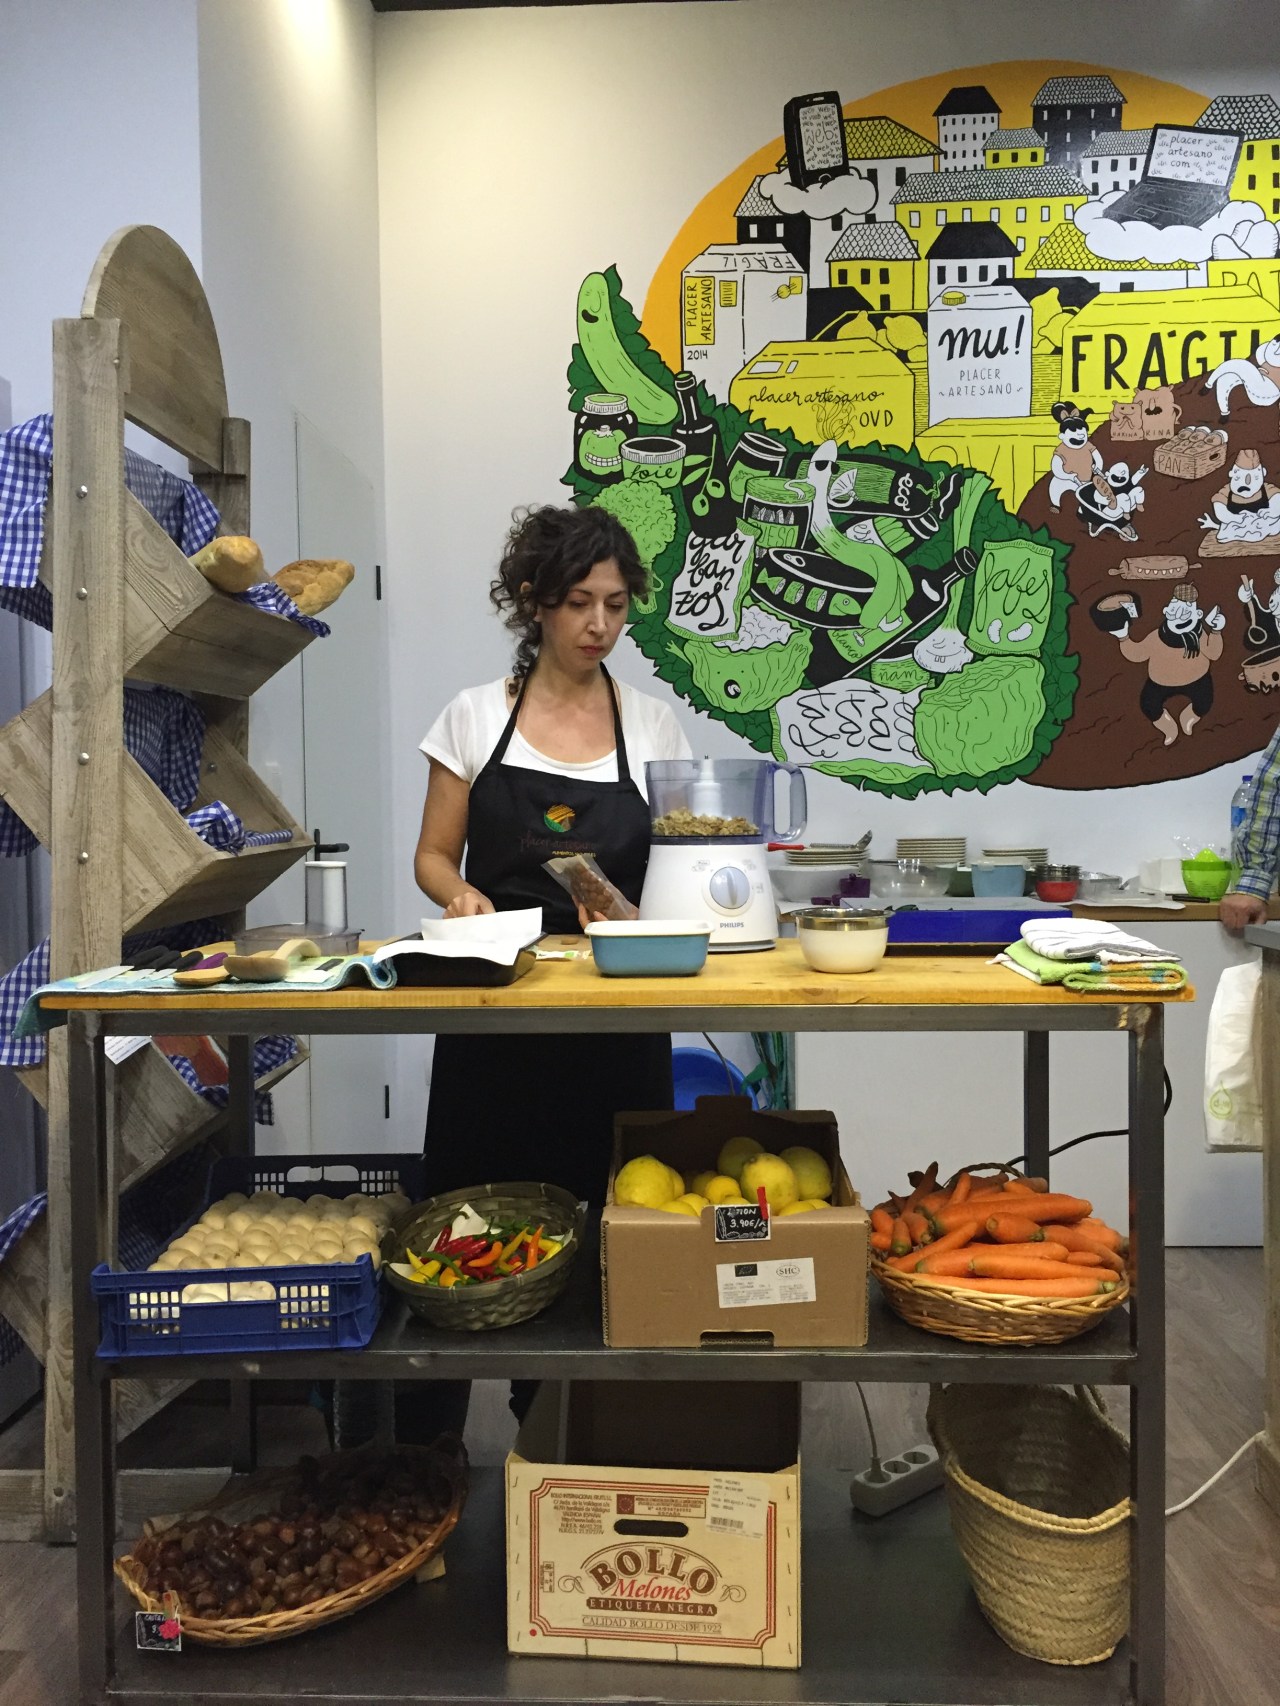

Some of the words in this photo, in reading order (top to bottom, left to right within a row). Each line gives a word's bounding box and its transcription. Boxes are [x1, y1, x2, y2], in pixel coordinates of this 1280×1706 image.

[1170, 132, 1204, 148] placer
[1168, 147, 1213, 158] artesano
[1170, 159, 1191, 168] com
[723, 255, 797, 270] FRAGIL
[686, 282, 698, 327] PLACER
[700, 278, 713, 341] ARTESANO
[937, 314, 1026, 361] mu!
[687, 349, 709, 361] 2014
[960, 368, 1001, 381] PLACER
[948, 383, 1012, 397] ARTESANO
[859, 409, 894, 427] OVD
[630, 464, 678, 481] foie
[1157, 454, 1182, 474] PAN
[893, 473, 914, 512] eco
[687, 553, 736, 591] ban
[675, 581, 730, 632] zos
[878, 668, 924, 682] ñam
[588, 1547, 716, 1594] BOLLO
[611, 1577, 693, 1601] Melones
[589, 1599, 662, 1612] ETIQUETA
[667, 1604, 714, 1615] NEGRA
[582, 1616, 627, 1627] CALIDAD
[629, 1619, 665, 1630] BOLLO
[666, 1622, 701, 1631] DESDE
[702, 1623, 722, 1633] 1922
